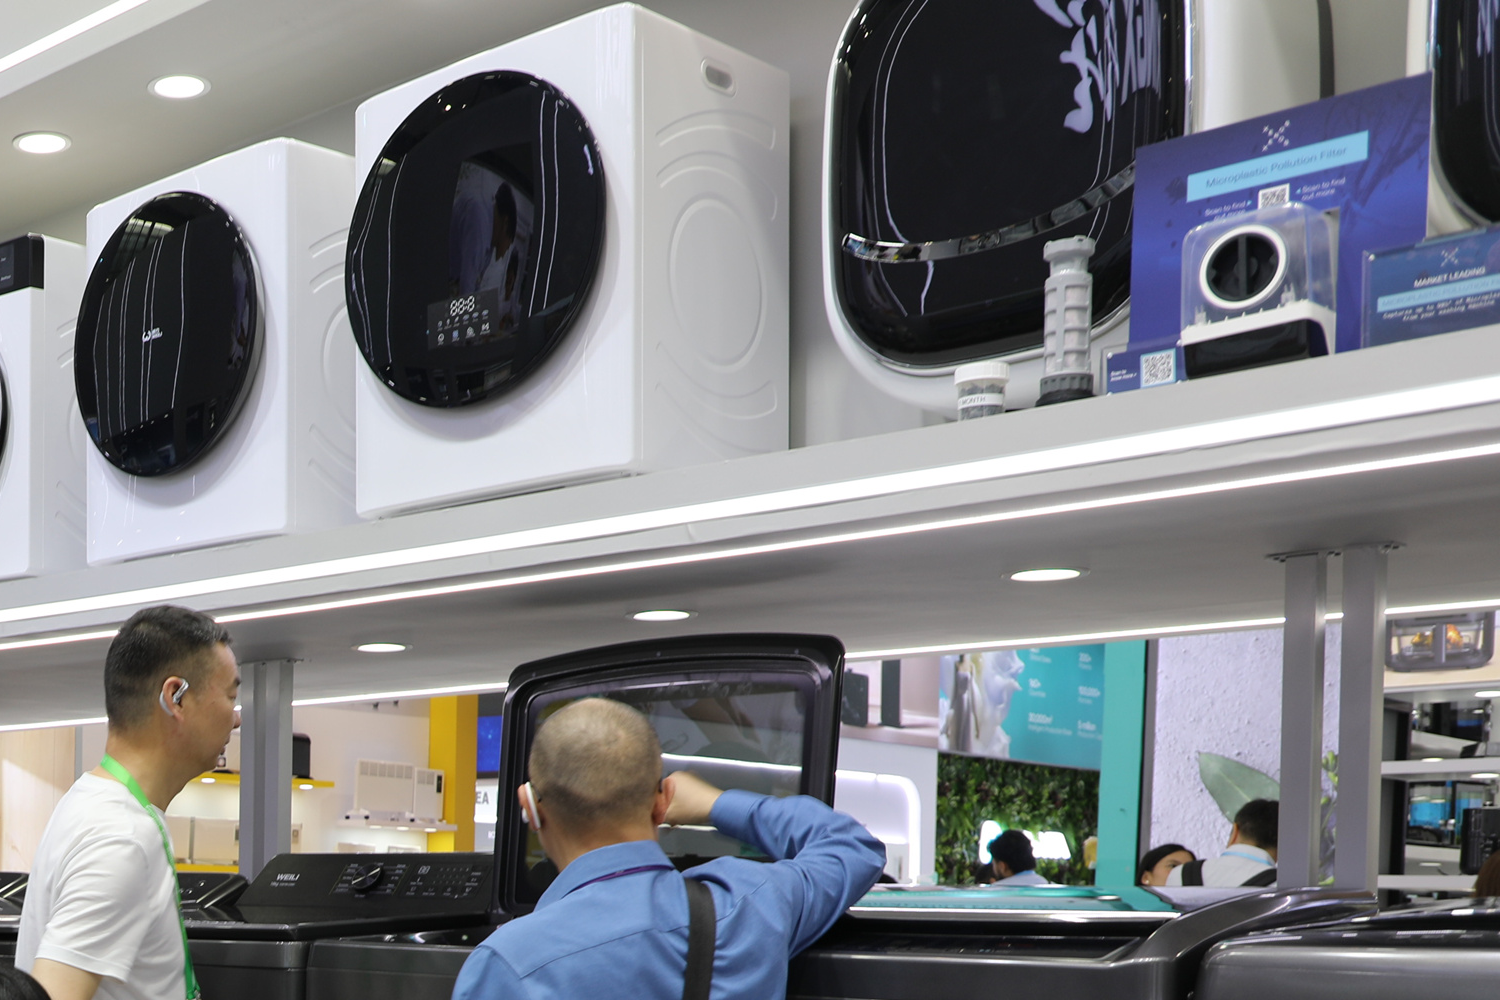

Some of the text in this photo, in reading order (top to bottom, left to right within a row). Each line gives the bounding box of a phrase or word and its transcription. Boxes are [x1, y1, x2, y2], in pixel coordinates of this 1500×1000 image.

[1206, 147, 1347, 188] Microplastic Pollution Filter
[1414, 266, 1485, 288] MARKET LEADING
[276, 873, 300, 881] WEILI
